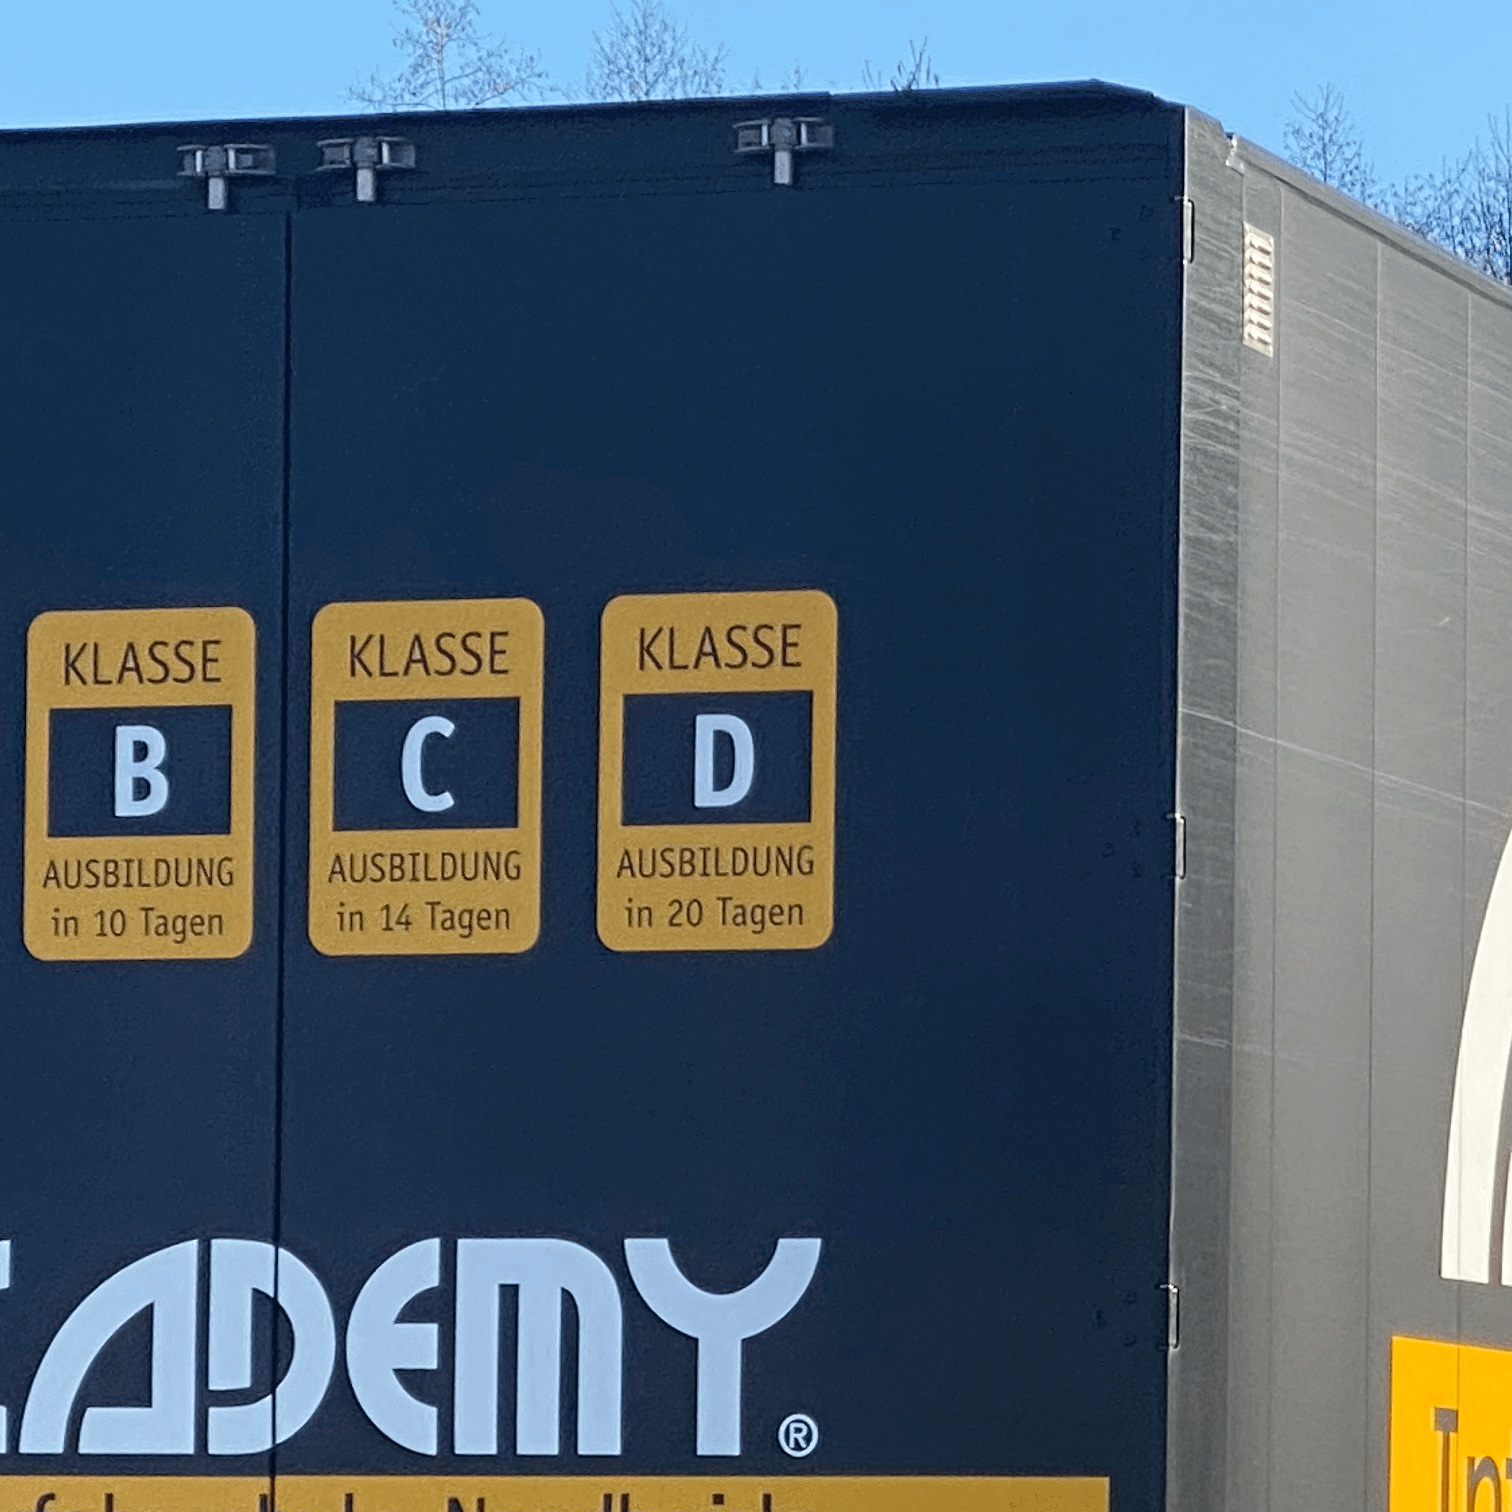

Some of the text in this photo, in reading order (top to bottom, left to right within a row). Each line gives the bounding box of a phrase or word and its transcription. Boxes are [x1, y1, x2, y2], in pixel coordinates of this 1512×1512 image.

[63, 640, 222, 686] KLASSE
[348, 631, 511, 677] KLASSE
[638, 624, 803, 671] KLASSE
[113, 724, 170, 818] B
[401, 715, 456, 813] C
[693, 713, 756, 809] D
[42, 856, 235, 889] AUSBILDUNG
[328, 850, 523, 883] AUSBILDUNG
[616, 845, 816, 879] AUSBILDUNG
[52, 907, 225, 945] in 10 Tagen
[337, 902, 512, 940] in 14 Tagen
[625, 898, 804, 936] in 20 Tagen
